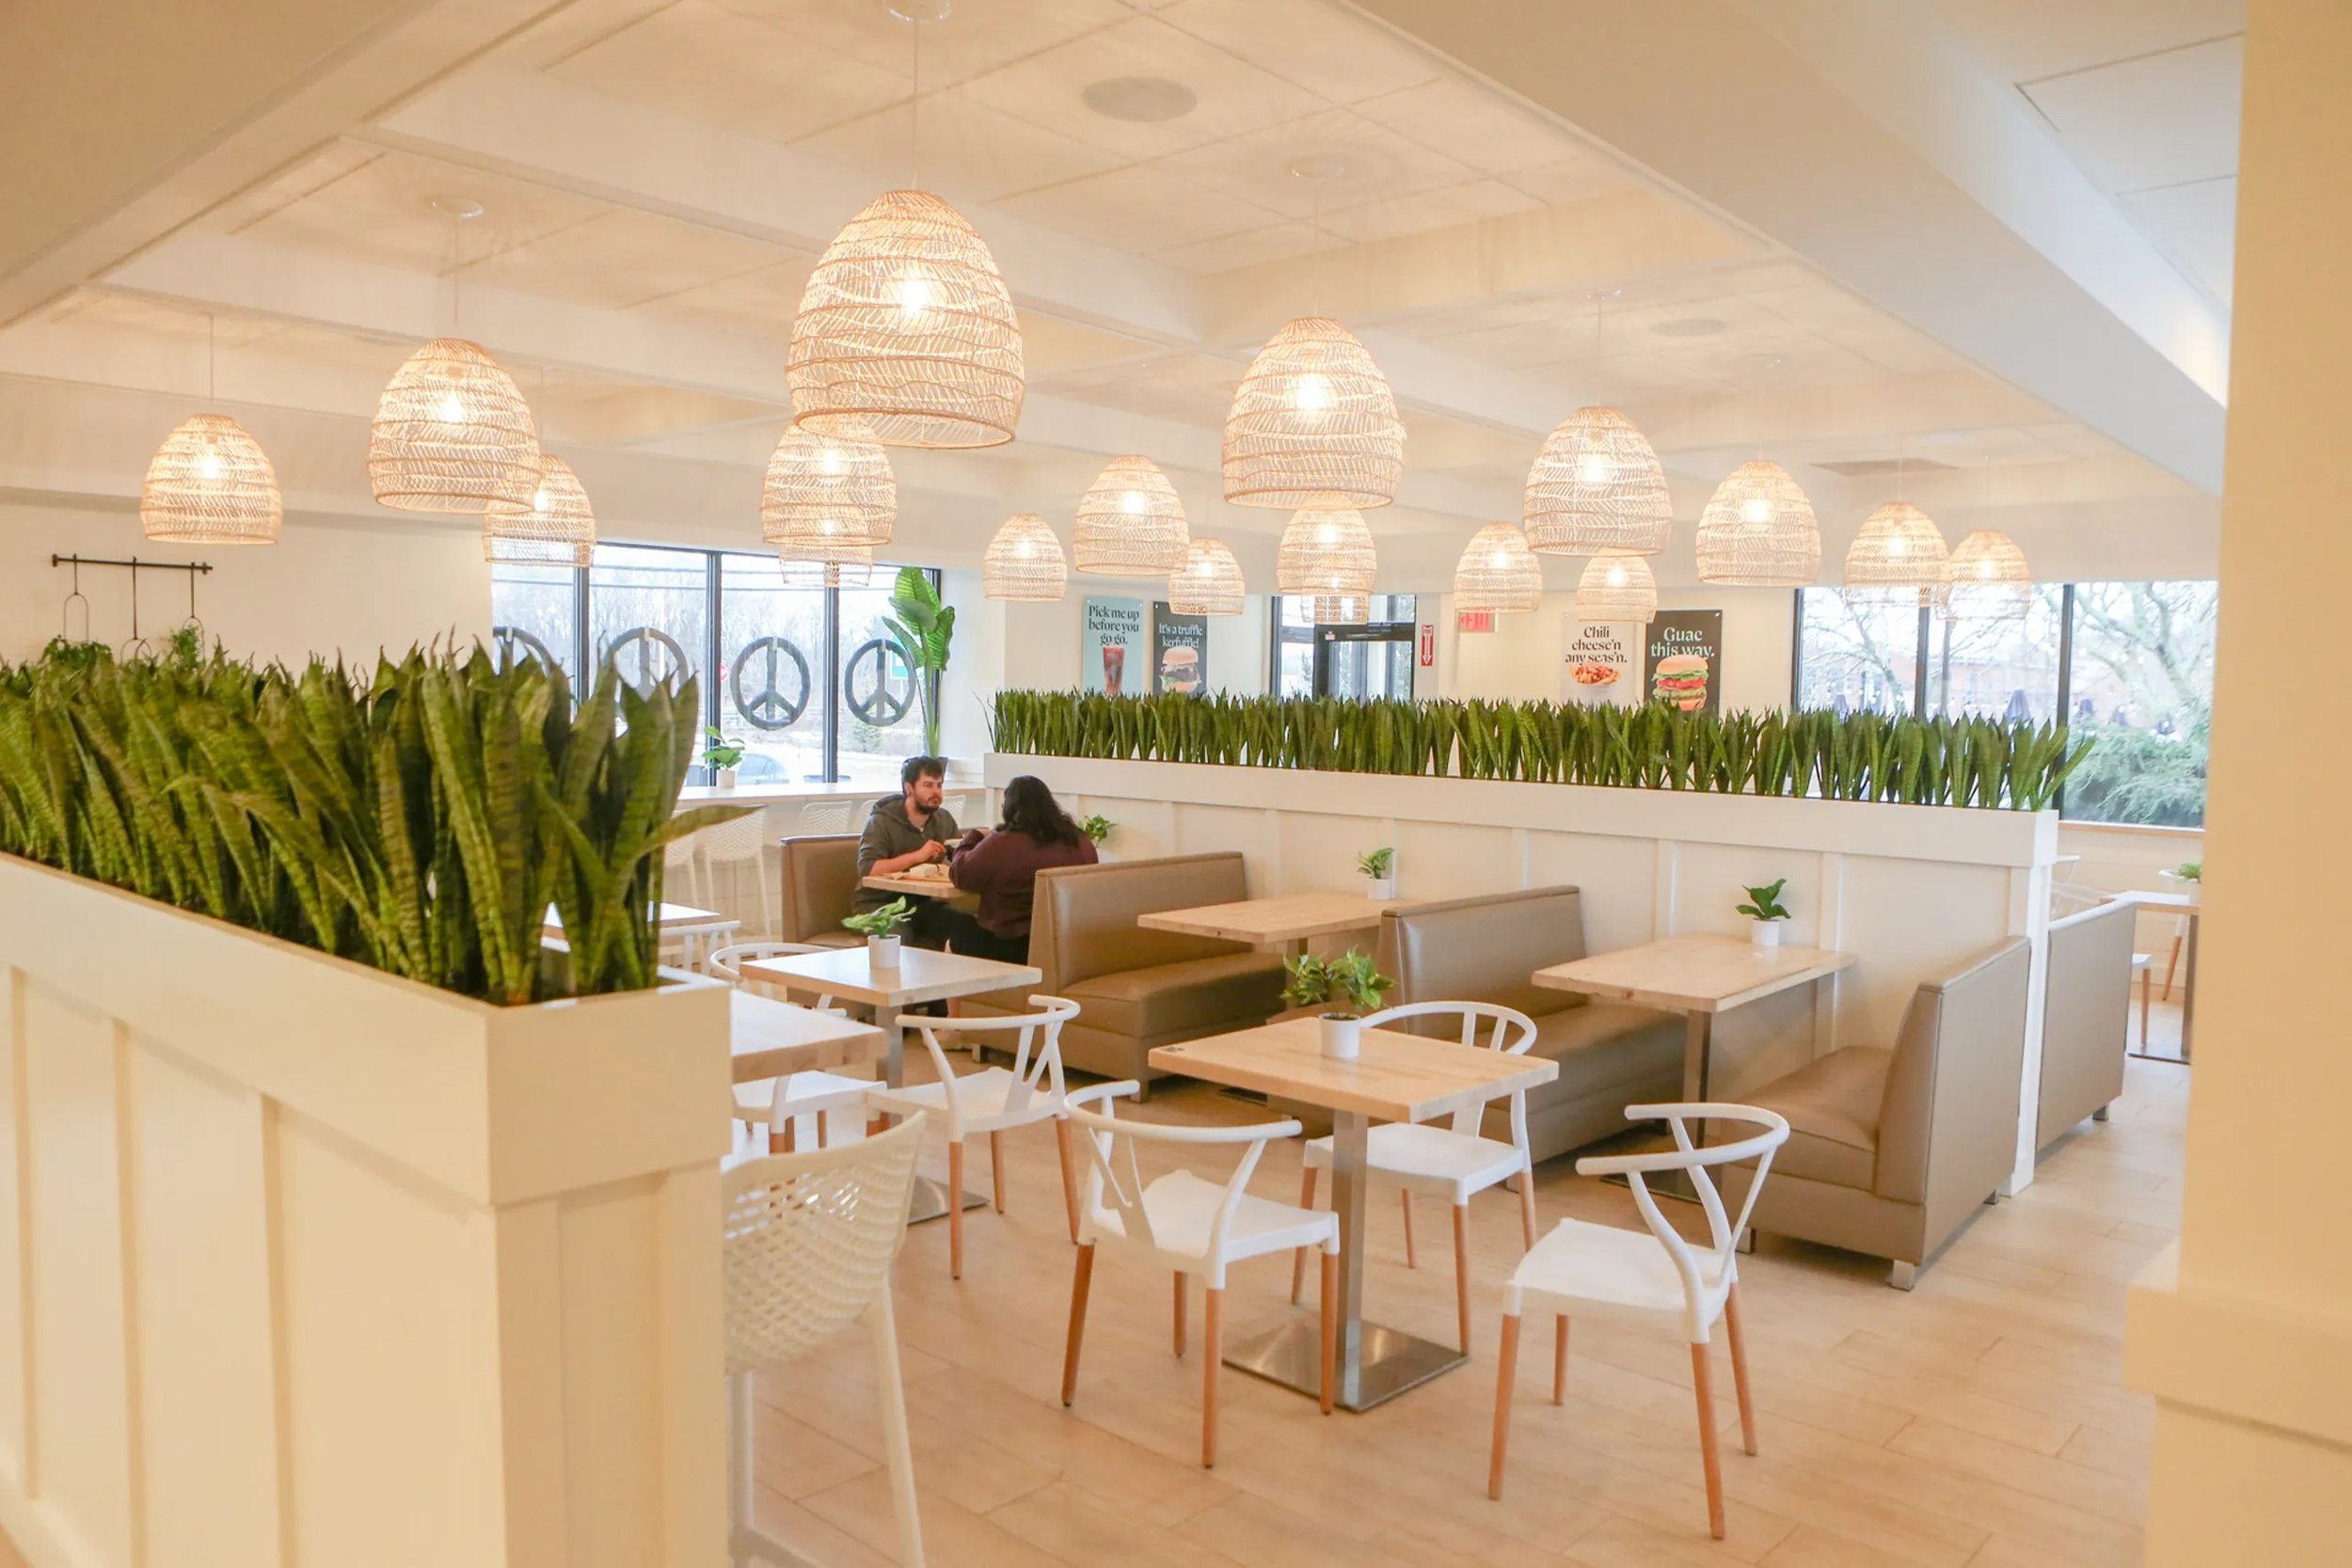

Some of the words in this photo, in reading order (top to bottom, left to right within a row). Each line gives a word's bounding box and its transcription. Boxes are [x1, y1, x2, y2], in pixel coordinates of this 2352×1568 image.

[1089, 605, 1109, 618] Pick
[1111, 610, 1126, 619] me
[1127, 610, 1140, 622] up
[1089, 618, 1120, 631] before
[1121, 623, 1139, 634] you
[1178, 624, 1203, 636] truffle
[1583, 626, 1610, 639] Chili
[1663, 626, 1703, 641] Guac
[1100, 633, 1113, 646] go
[1114, 634, 1128, 646] go.
[1571, 639, 1622, 651] cheese'n
[1565, 653, 1586, 666] any
[1588, 651, 1628, 663] seas'n.
[1650, 641, 1679, 657] this
[1681, 645, 1715, 661] way.
